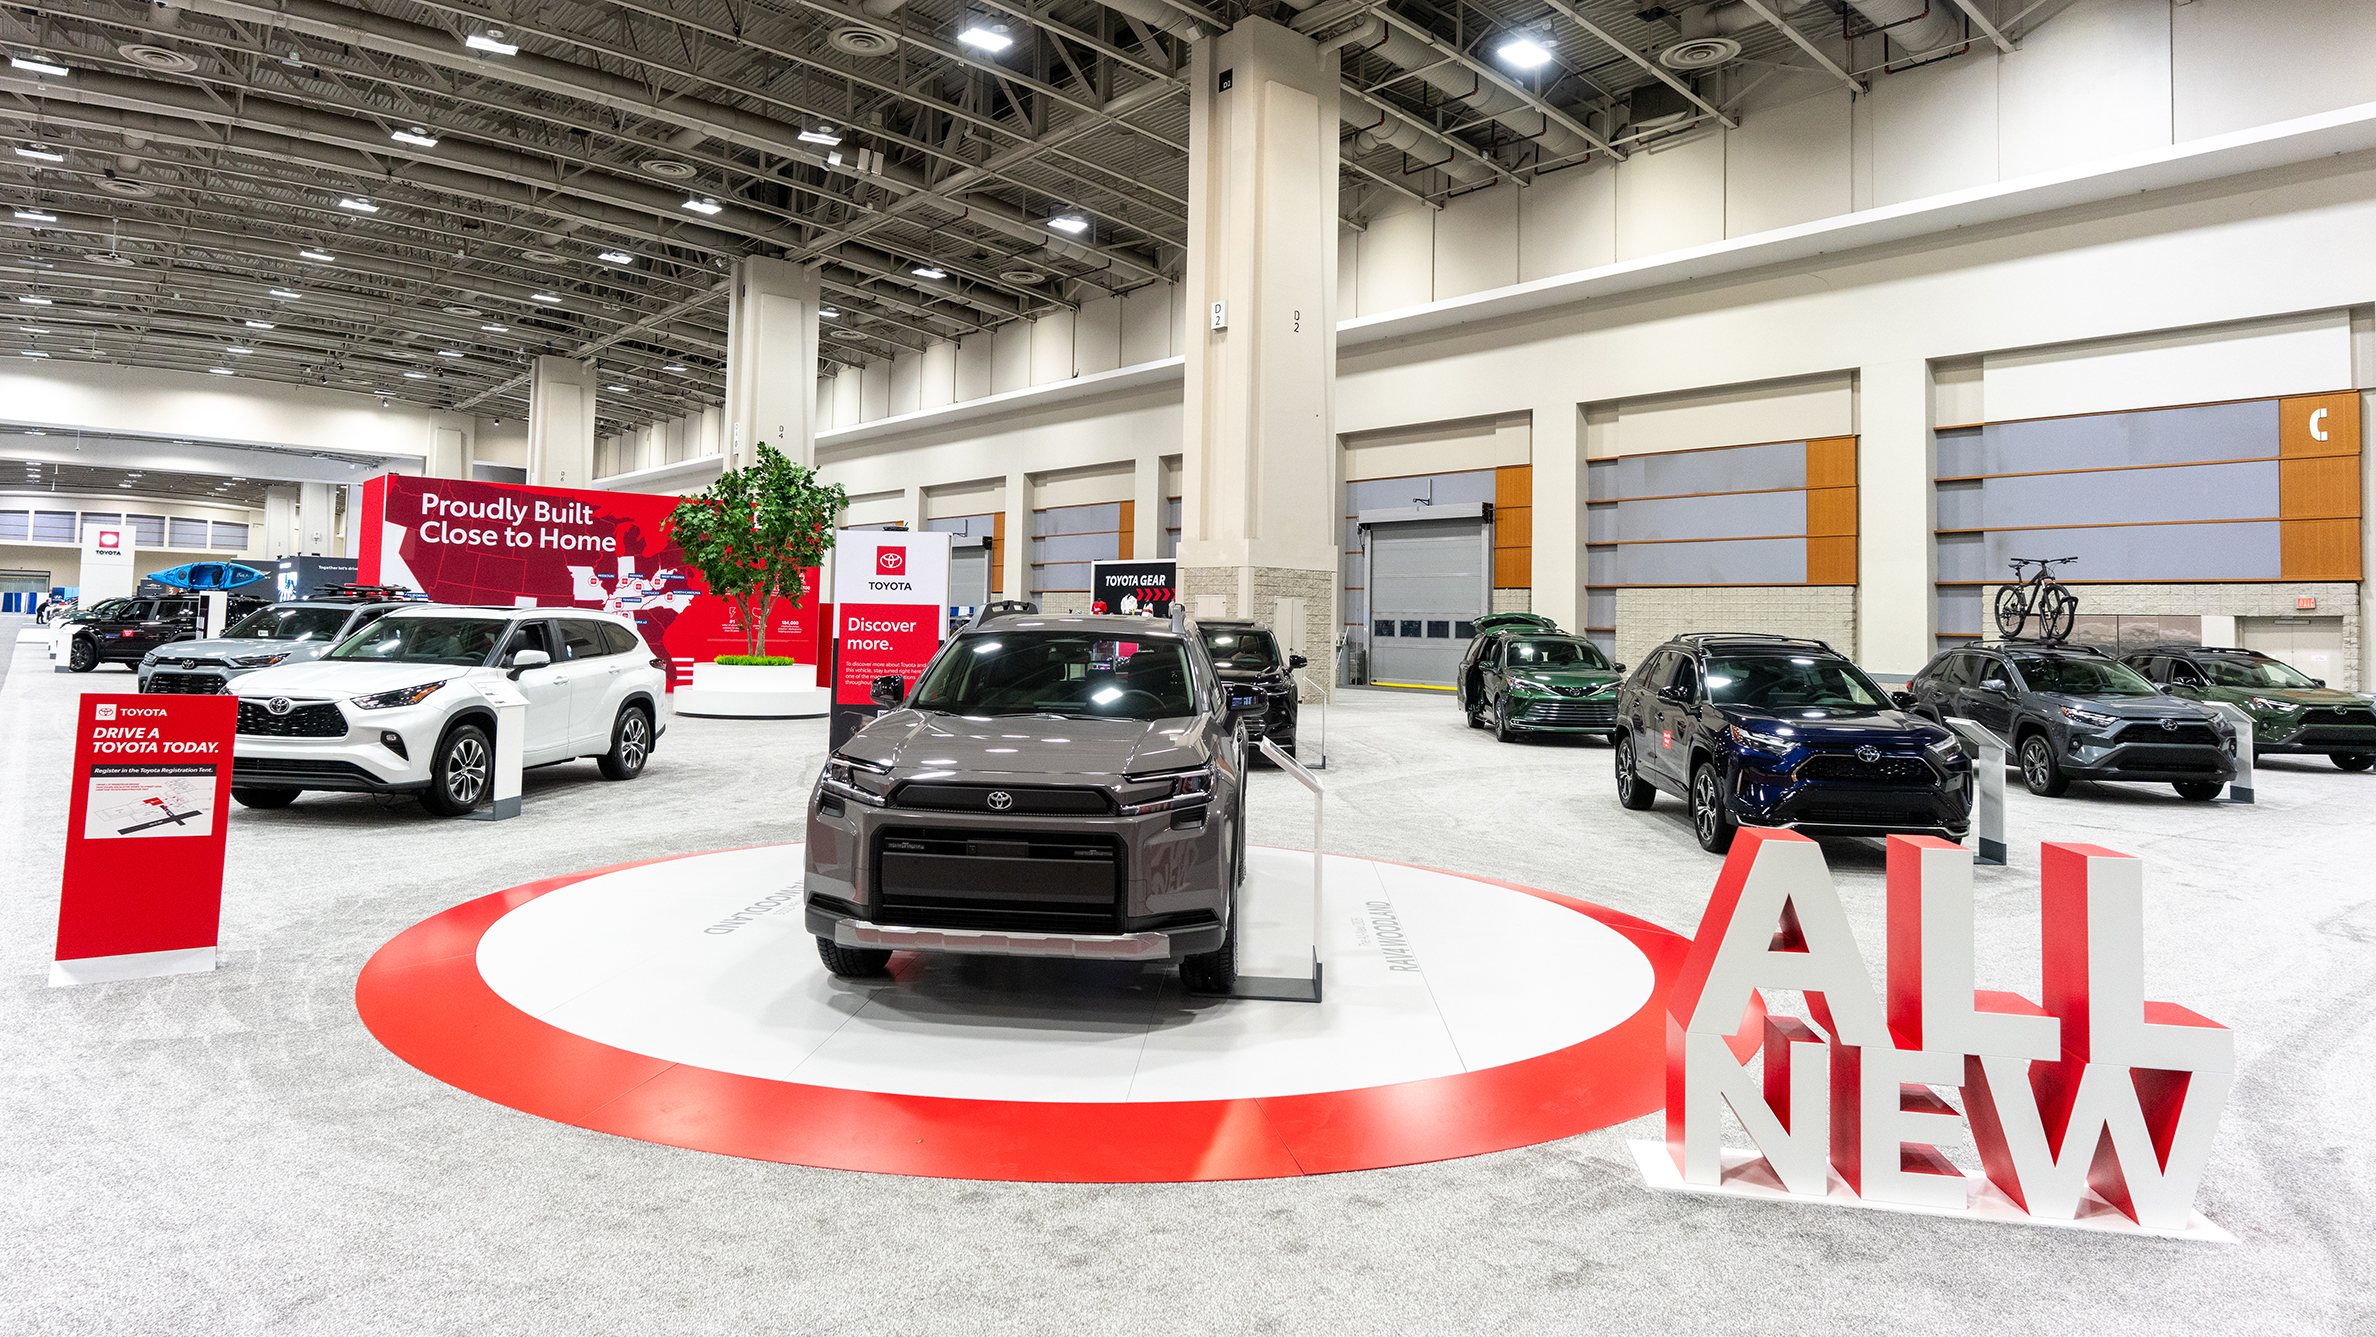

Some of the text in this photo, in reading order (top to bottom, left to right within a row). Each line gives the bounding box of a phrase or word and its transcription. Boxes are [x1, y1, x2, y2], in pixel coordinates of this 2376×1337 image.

[421, 492, 594, 526] Proudly Built
[419, 521, 617, 552] Close to Home
[868, 581, 912, 591] TOYOTA
[1105, 574, 1166, 587] TOYOTA GEAR
[848, 617, 917, 632] Discover
[847, 640, 894, 651] more.
[120, 708, 168, 717] TOYOTA
[92, 727, 160, 739] DRIVE A
[93, 742, 219, 753] TOYOTA TODAY.
[703, 889, 804, 935] WOODLAND
[1365, 900, 1420, 973] RAV4 WOODLAND
[1678, 834, 2234, 1073] ALL
[1684, 1034, 2234, 1231] NEW
